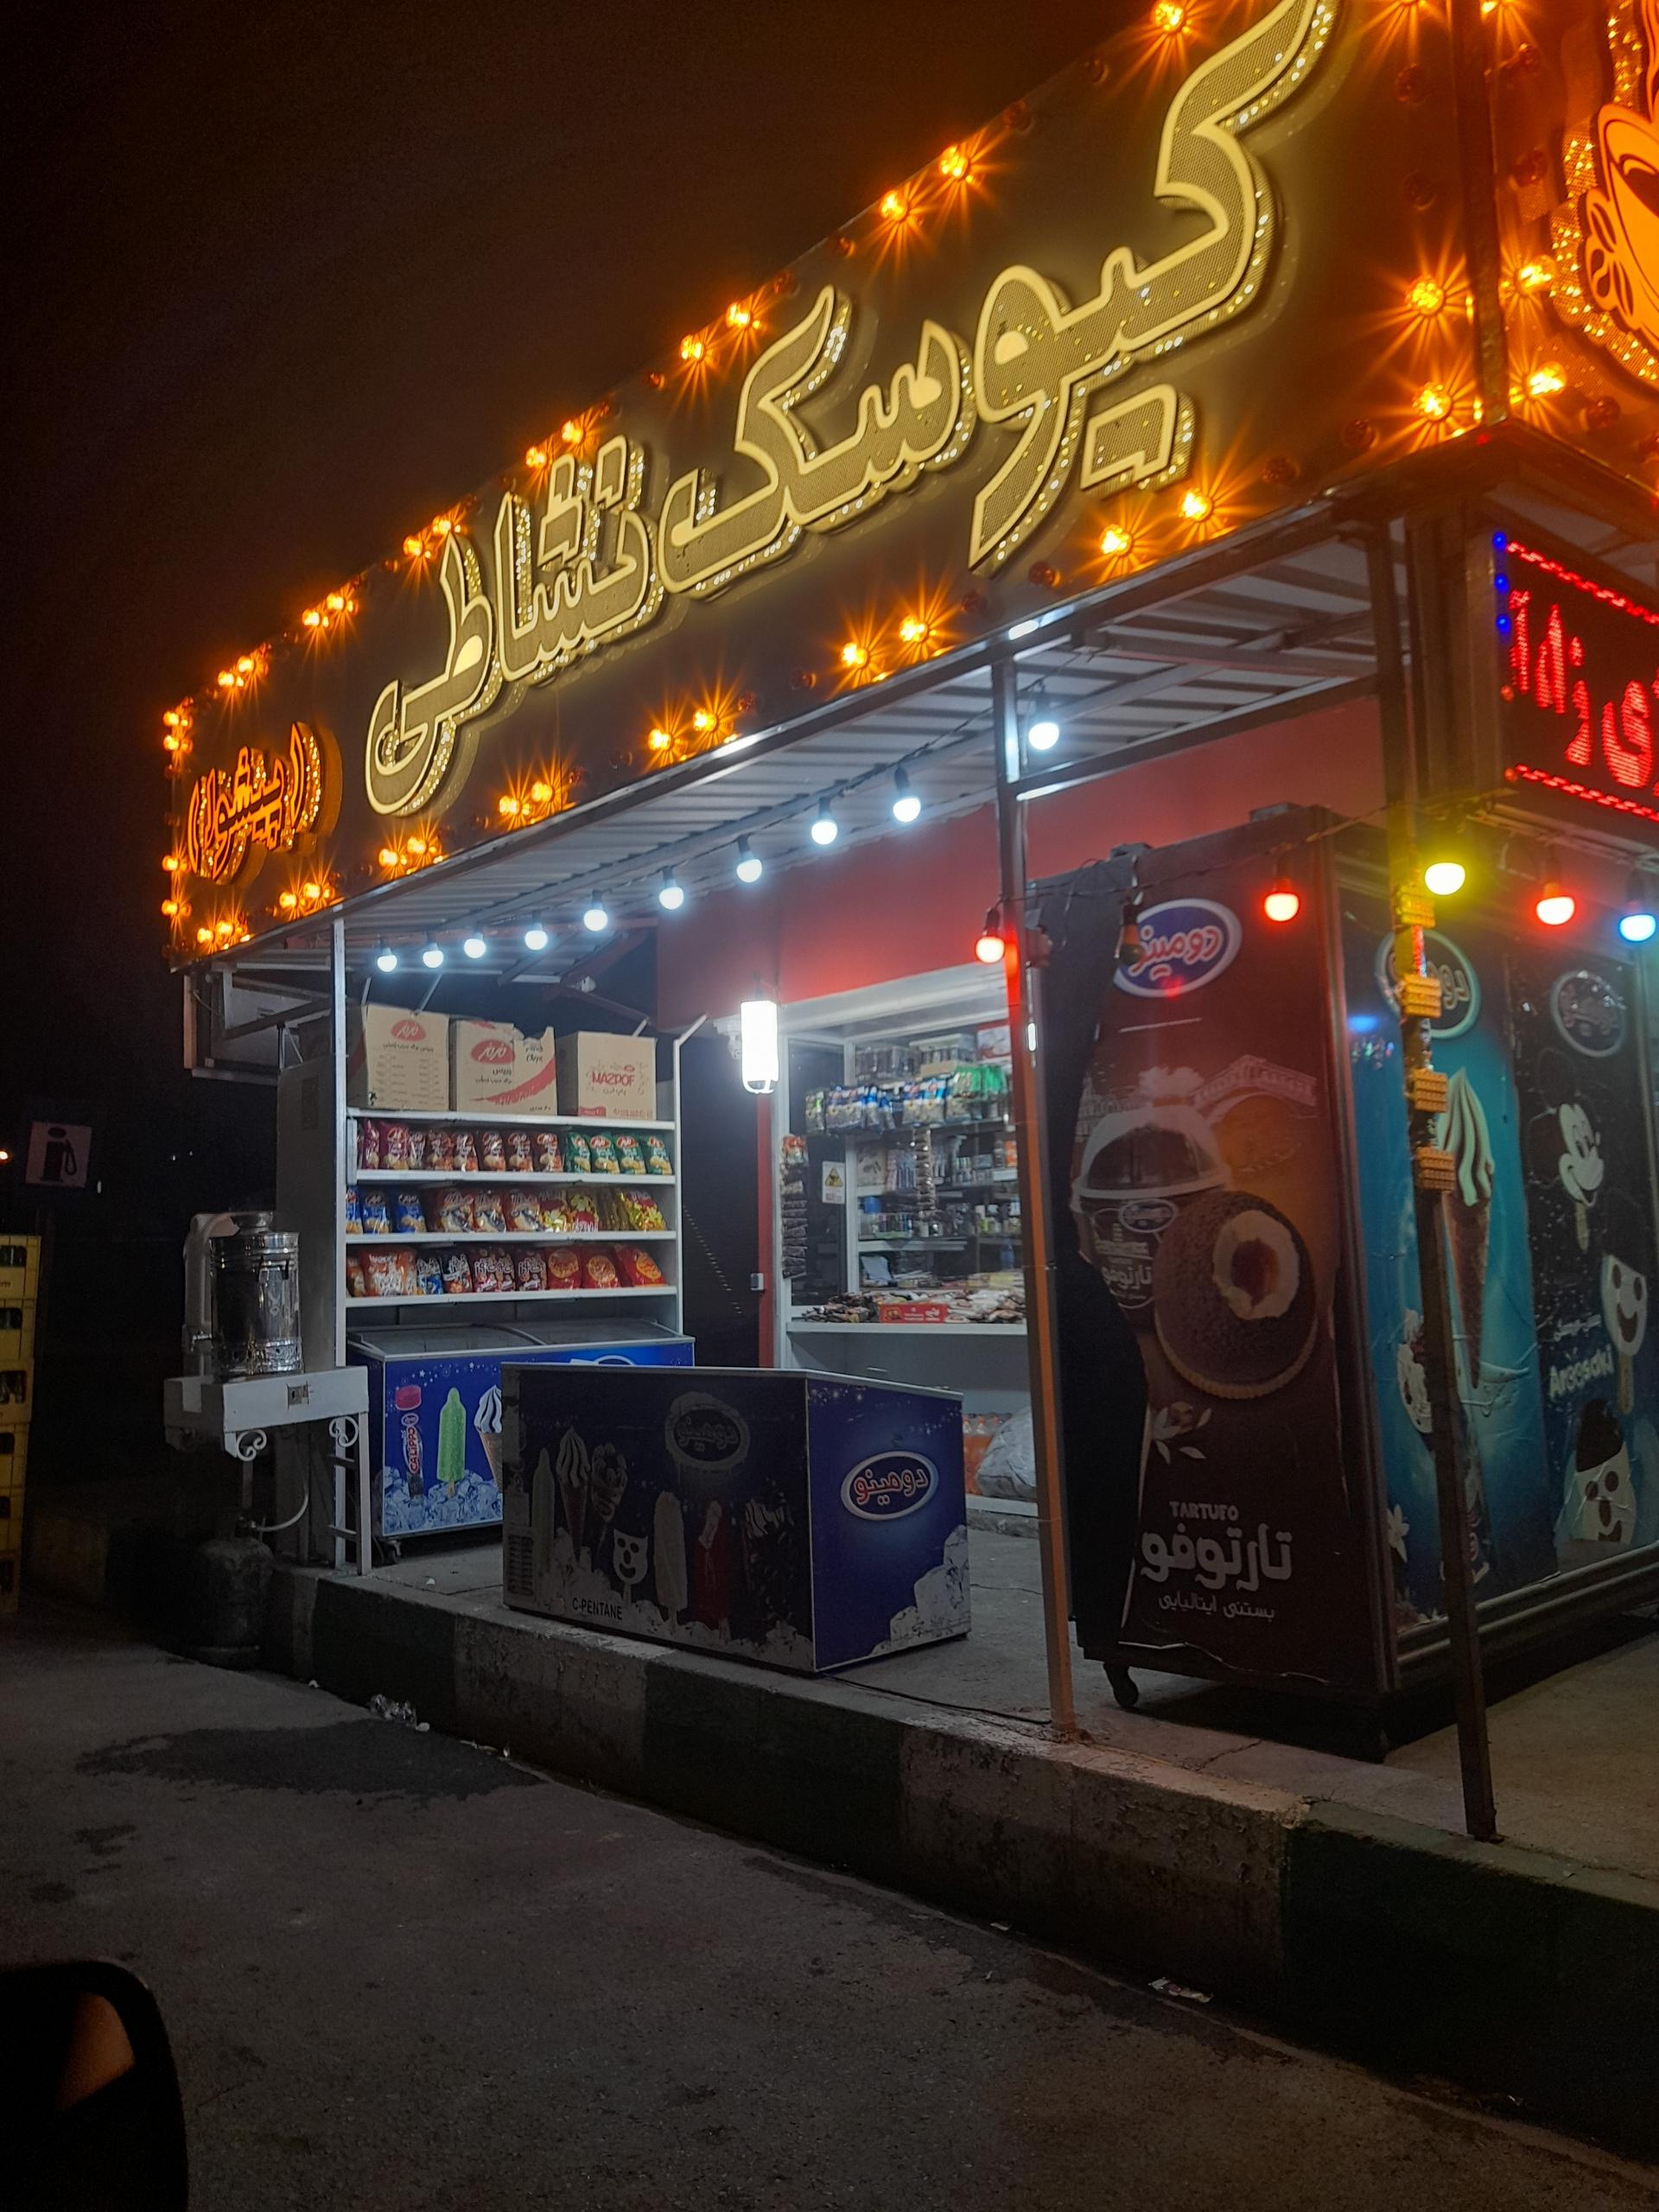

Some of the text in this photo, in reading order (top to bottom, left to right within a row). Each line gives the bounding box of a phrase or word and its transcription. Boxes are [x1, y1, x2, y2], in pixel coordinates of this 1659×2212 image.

[365, 0, 1335, 817] کیوسک نشاطی
[407, 1427, 419, 1472] CALIPPO
[854, 1468, 929, 1506] دومینو
[1168, 1500, 1240, 1522] TARTUFO
[1140, 1522, 1294, 1592] تارتوفو
[572, 1597, 623, 1621] C-PENTANE
[1158, 1590, 1275, 1623] بستنی ایتالیایی
